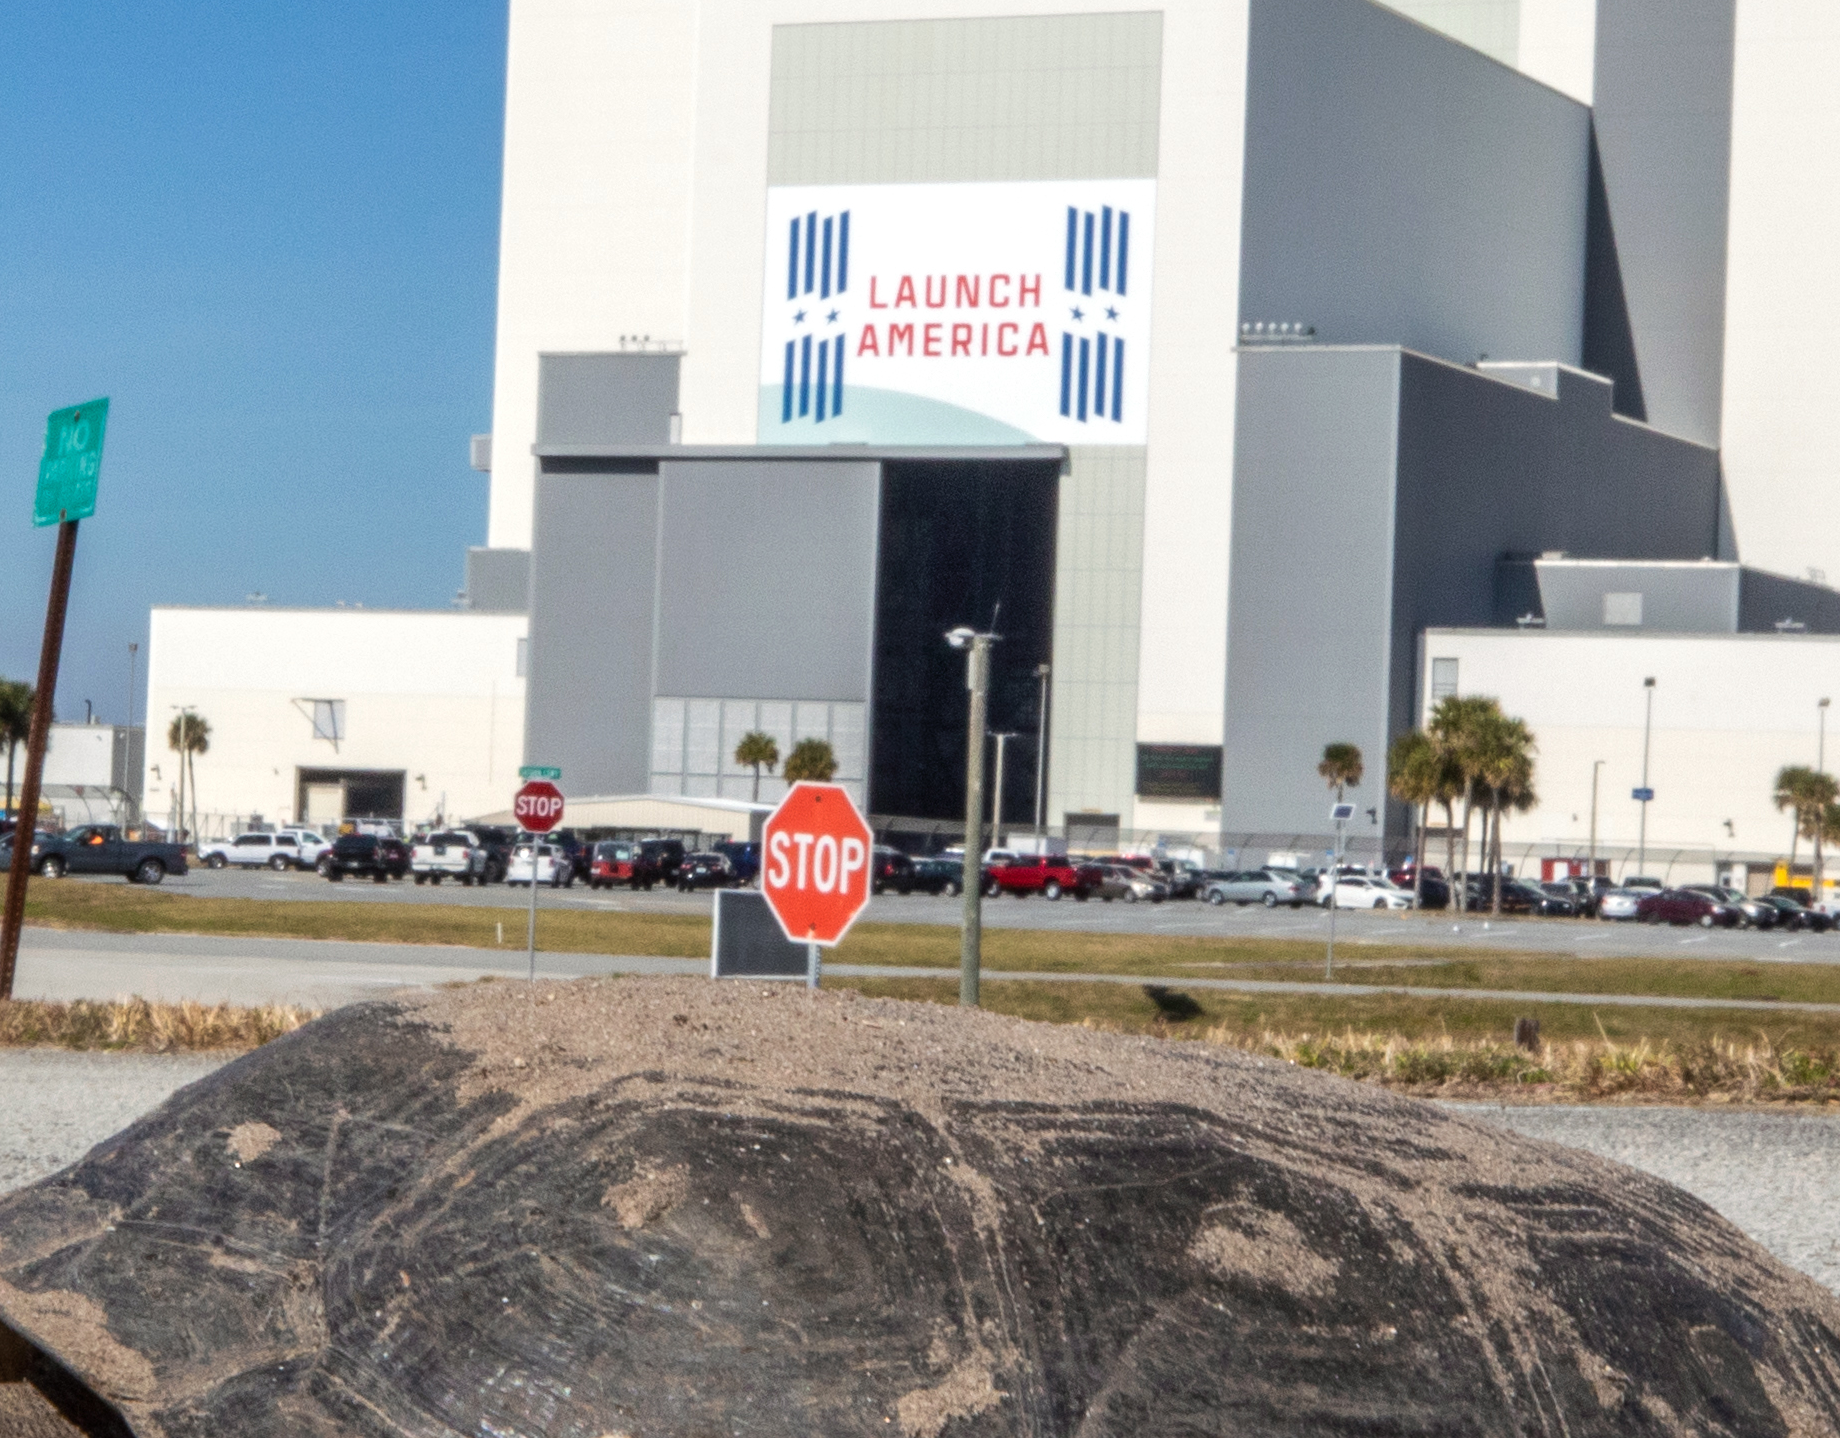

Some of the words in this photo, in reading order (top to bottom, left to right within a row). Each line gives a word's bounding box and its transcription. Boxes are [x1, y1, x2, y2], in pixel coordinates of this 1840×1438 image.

[869, 273, 1042, 309] LAUNCH
[856, 321, 1050, 357] AMERICA
[515, 794, 562, 817] STOP
[767, 830, 866, 895] STOP
